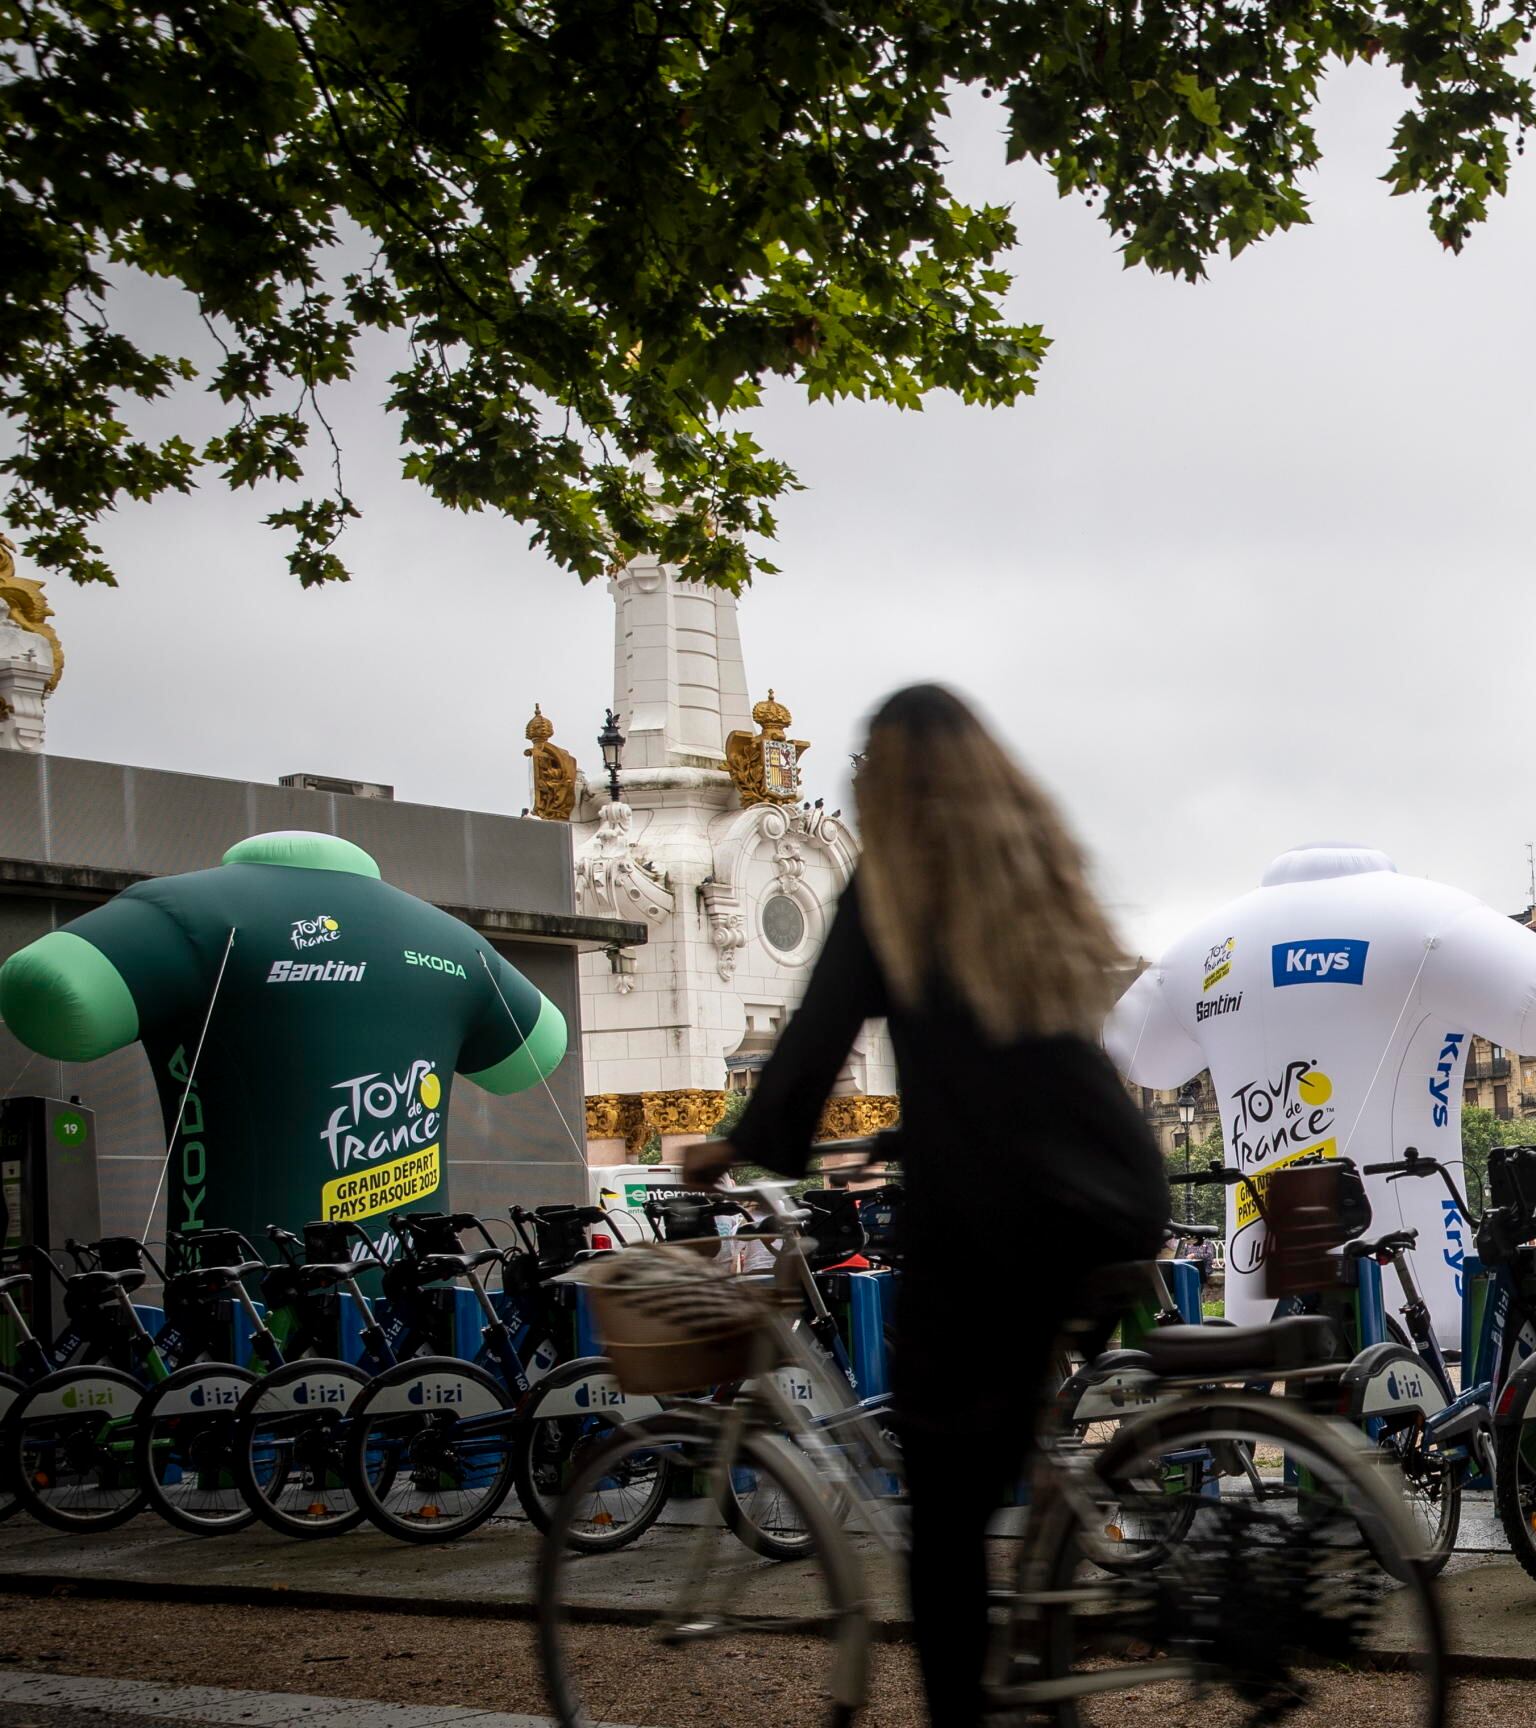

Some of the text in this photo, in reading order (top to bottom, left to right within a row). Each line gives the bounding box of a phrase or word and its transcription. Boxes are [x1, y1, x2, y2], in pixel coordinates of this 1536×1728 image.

[266, 960, 367, 983] Santini
[1286, 948, 1350, 976] Krys
[1196, 991, 1243, 1023] Santini
[1429, 1033, 1464, 1127] Krys
[407, 1097, 422, 1118] de
[1286, 1099, 1302, 1119] de
[63, 1123, 78, 1135] 19
[167, 1043, 206, 1231] KODA
[328, 1169, 438, 1222] PAYS BASQUE 2023
[336, 1170, 390, 1200] GRAND
[1238, 1200, 1256, 1222] PAYS
[514, 1372, 528, 1392] 160
[845, 1367, 858, 1388] 296
